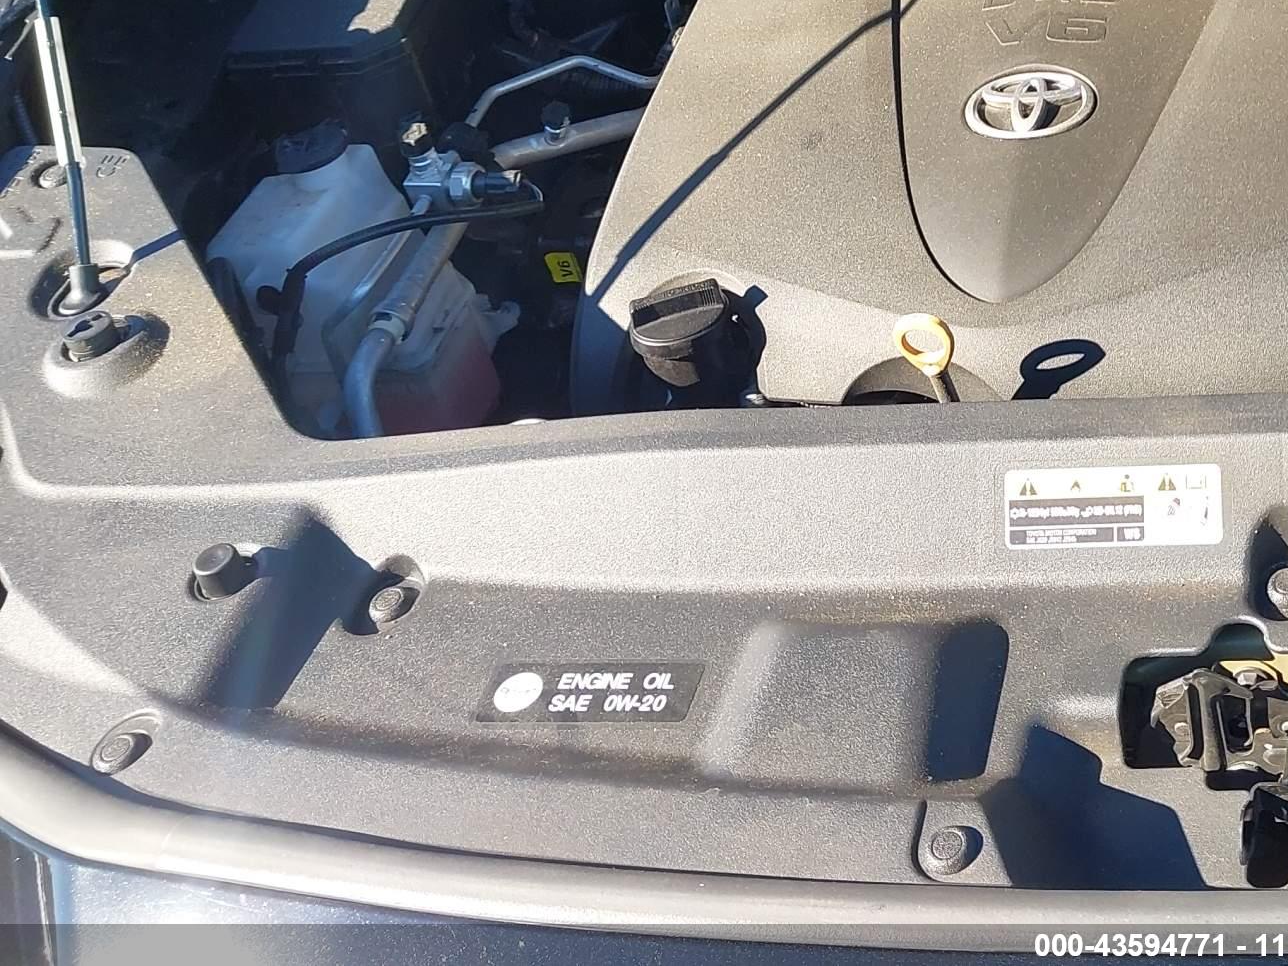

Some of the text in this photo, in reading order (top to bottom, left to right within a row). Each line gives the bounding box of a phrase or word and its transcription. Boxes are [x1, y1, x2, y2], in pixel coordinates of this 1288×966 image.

[985, 17, 1108, 46] V6
[557, 672, 674, 689] ENGINE OIL
[549, 694, 667, 712] SAE 0W-20
